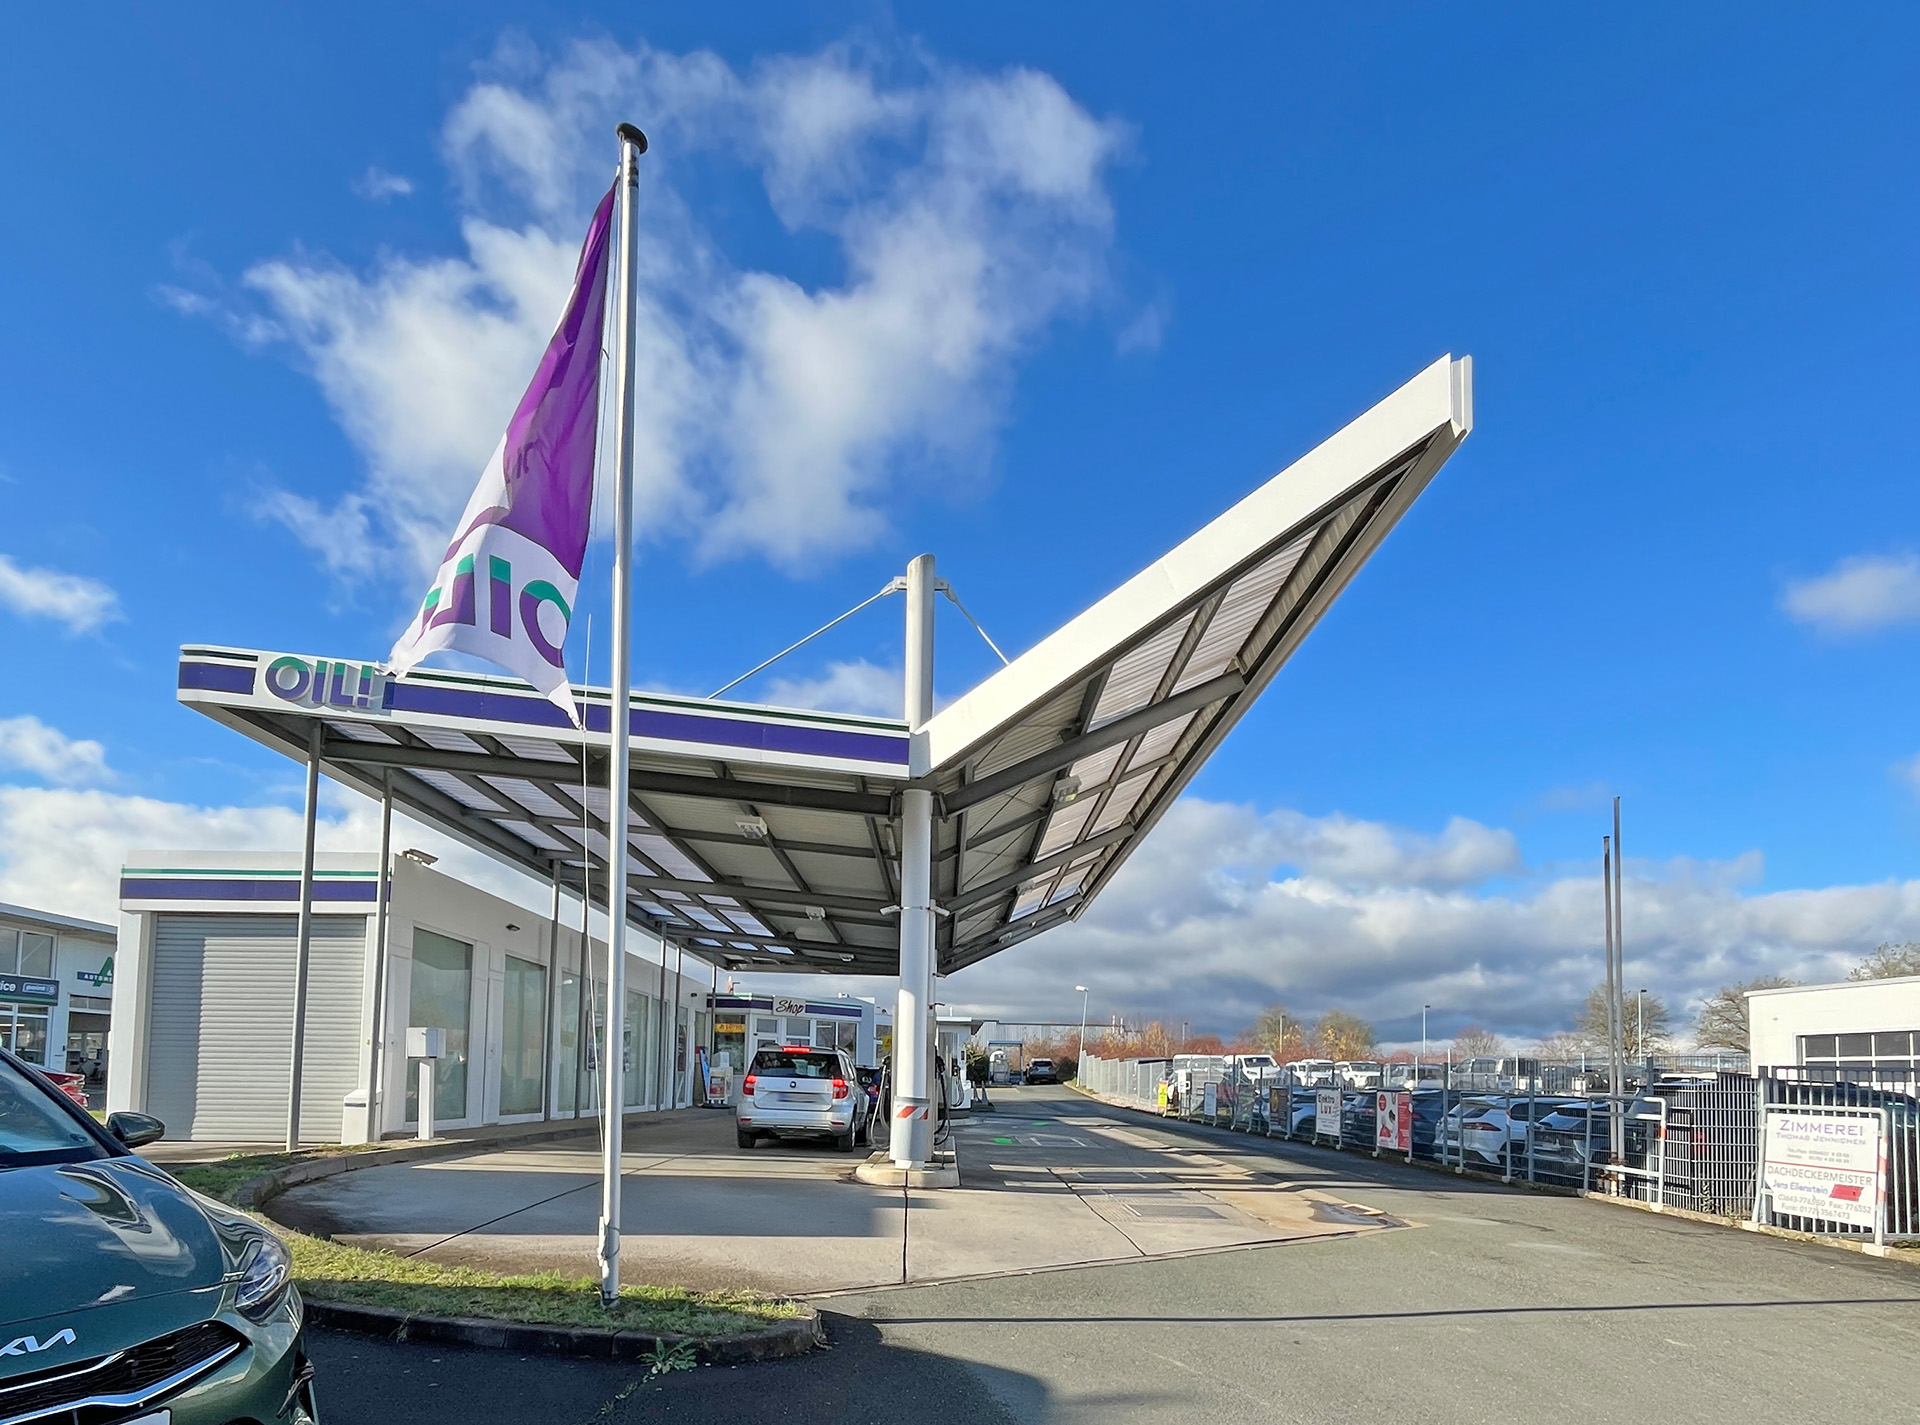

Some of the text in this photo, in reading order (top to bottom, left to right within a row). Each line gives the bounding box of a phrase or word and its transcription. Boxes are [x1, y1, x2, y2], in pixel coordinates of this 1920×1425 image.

[265, 656, 374, 709] OIL!
[776, 1000, 804, 1016] Shop
[1780, 1119, 1863, 1136] ZIMMEREI
[1767, 1165, 1873, 1186] DACHDECKERMEISTER
[1773, 1180, 1788, 1189] Jens
